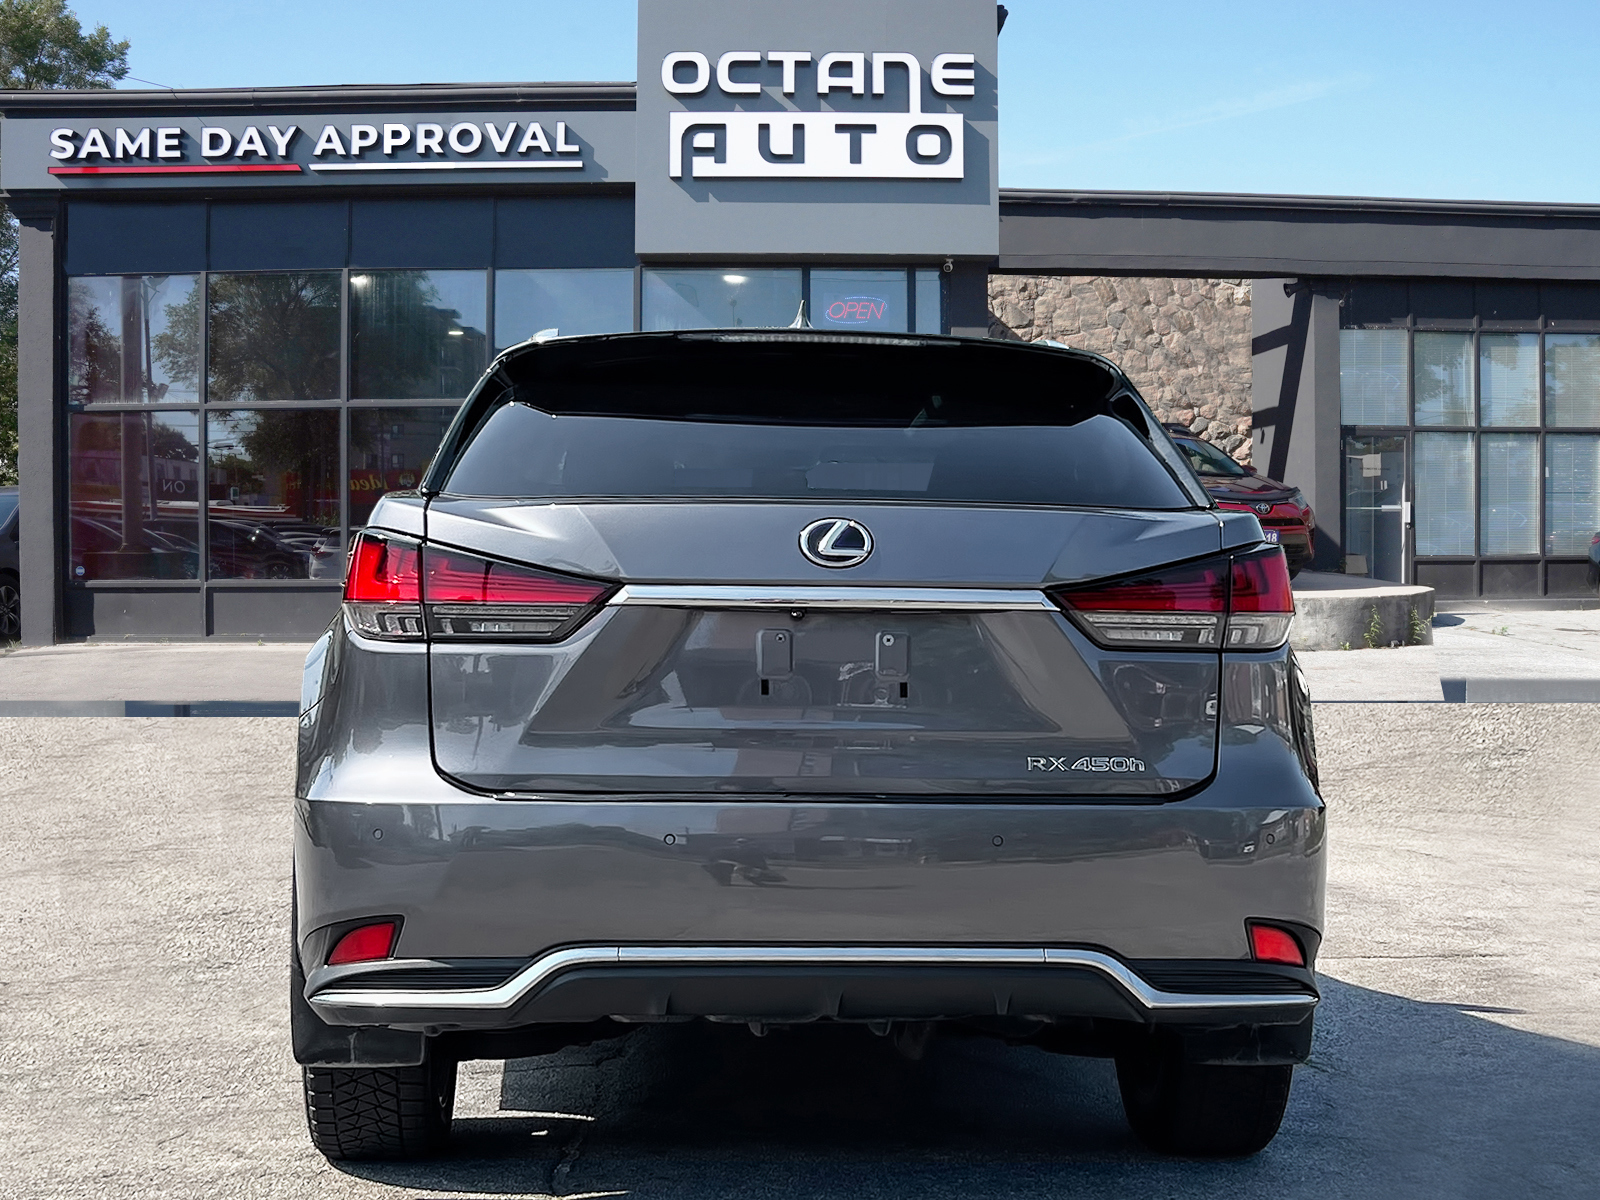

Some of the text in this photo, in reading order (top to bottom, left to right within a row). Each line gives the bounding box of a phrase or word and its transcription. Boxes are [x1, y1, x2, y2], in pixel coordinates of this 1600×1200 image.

[661, 51, 976, 99] OCTANE
[49, 121, 580, 160] SAME DAY APPROVAL
[680, 122, 954, 172] AUTO
[828, 301, 885, 319] OPEN
[1265, 532, 1278, 543] 18
[1026, 755, 1146, 772] RX 450h
